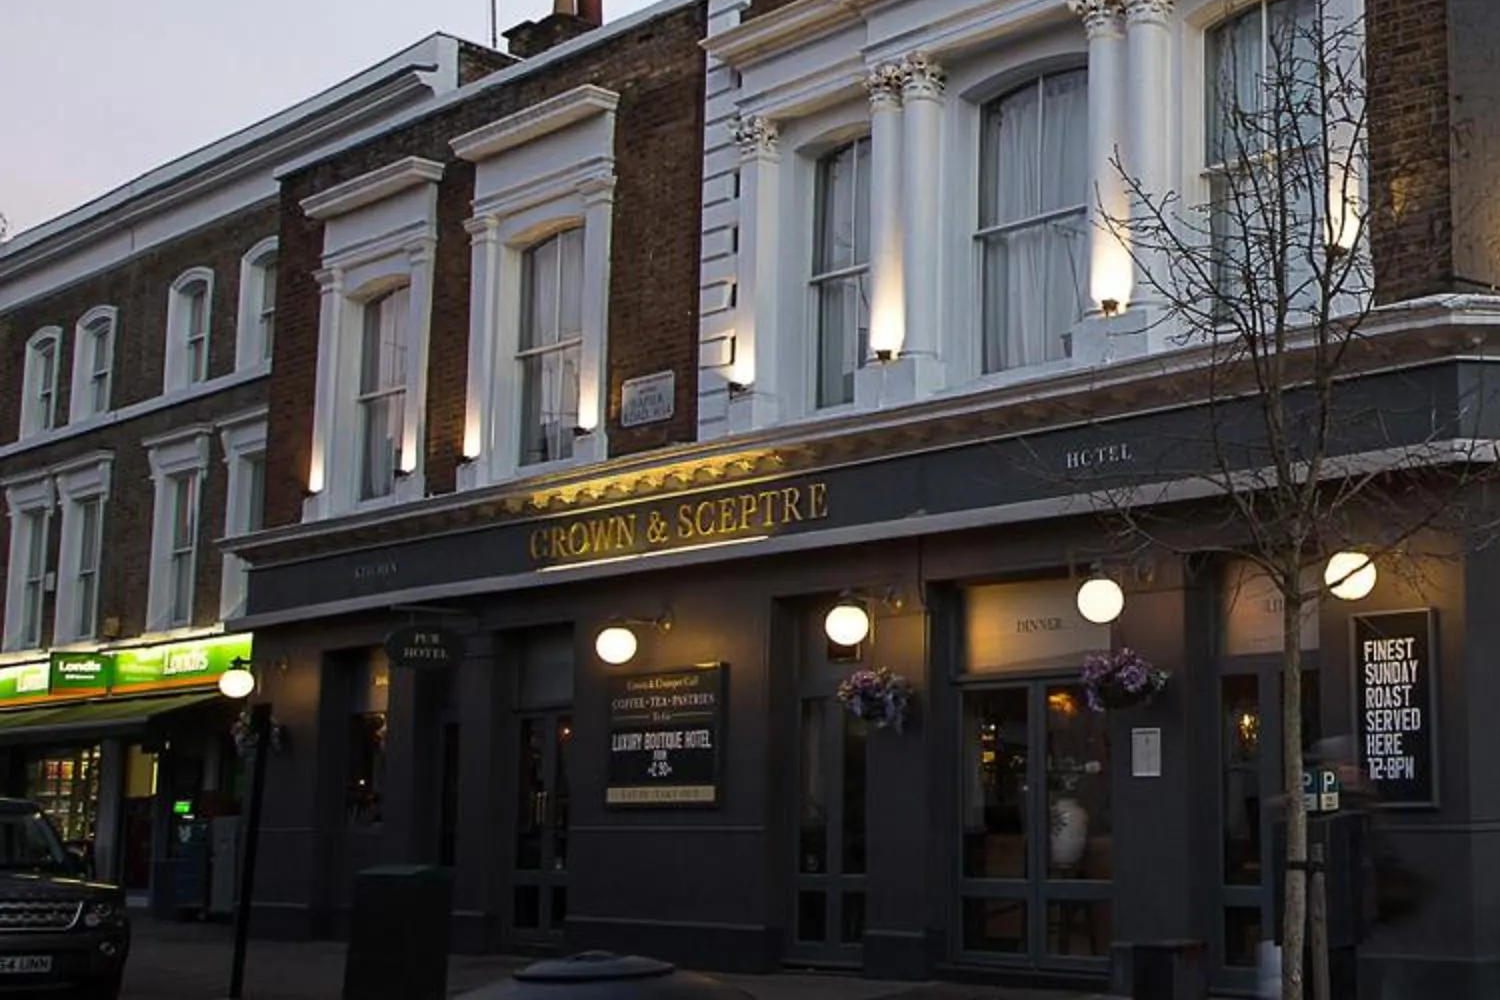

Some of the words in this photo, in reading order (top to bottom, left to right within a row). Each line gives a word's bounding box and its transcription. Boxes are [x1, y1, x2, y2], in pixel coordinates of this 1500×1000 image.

[1066, 443, 1135, 469] HOTEL
[530, 513, 636, 559] CROWN
[646, 511, 669, 544] &
[678, 482, 829, 539] SCEPTRE
[1016, 616, 1064, 633] DINNER
[402, 647, 449, 660] HOTEL
[1363, 637, 1415, 662] FINEST
[59, 660, 102, 673] Londis
[1365, 659, 1419, 685] SUNDAY
[1365, 685, 1413, 709] ROAST
[1365, 707, 1421, 732] SERVED
[612, 732, 643, 752] LUXURY
[644, 731, 683, 751] BOUTIQUE
[684, 729, 713, 749] HOTEL
[1366, 732, 1403, 755] HERE
[1323, 770, 1335, 793] P
